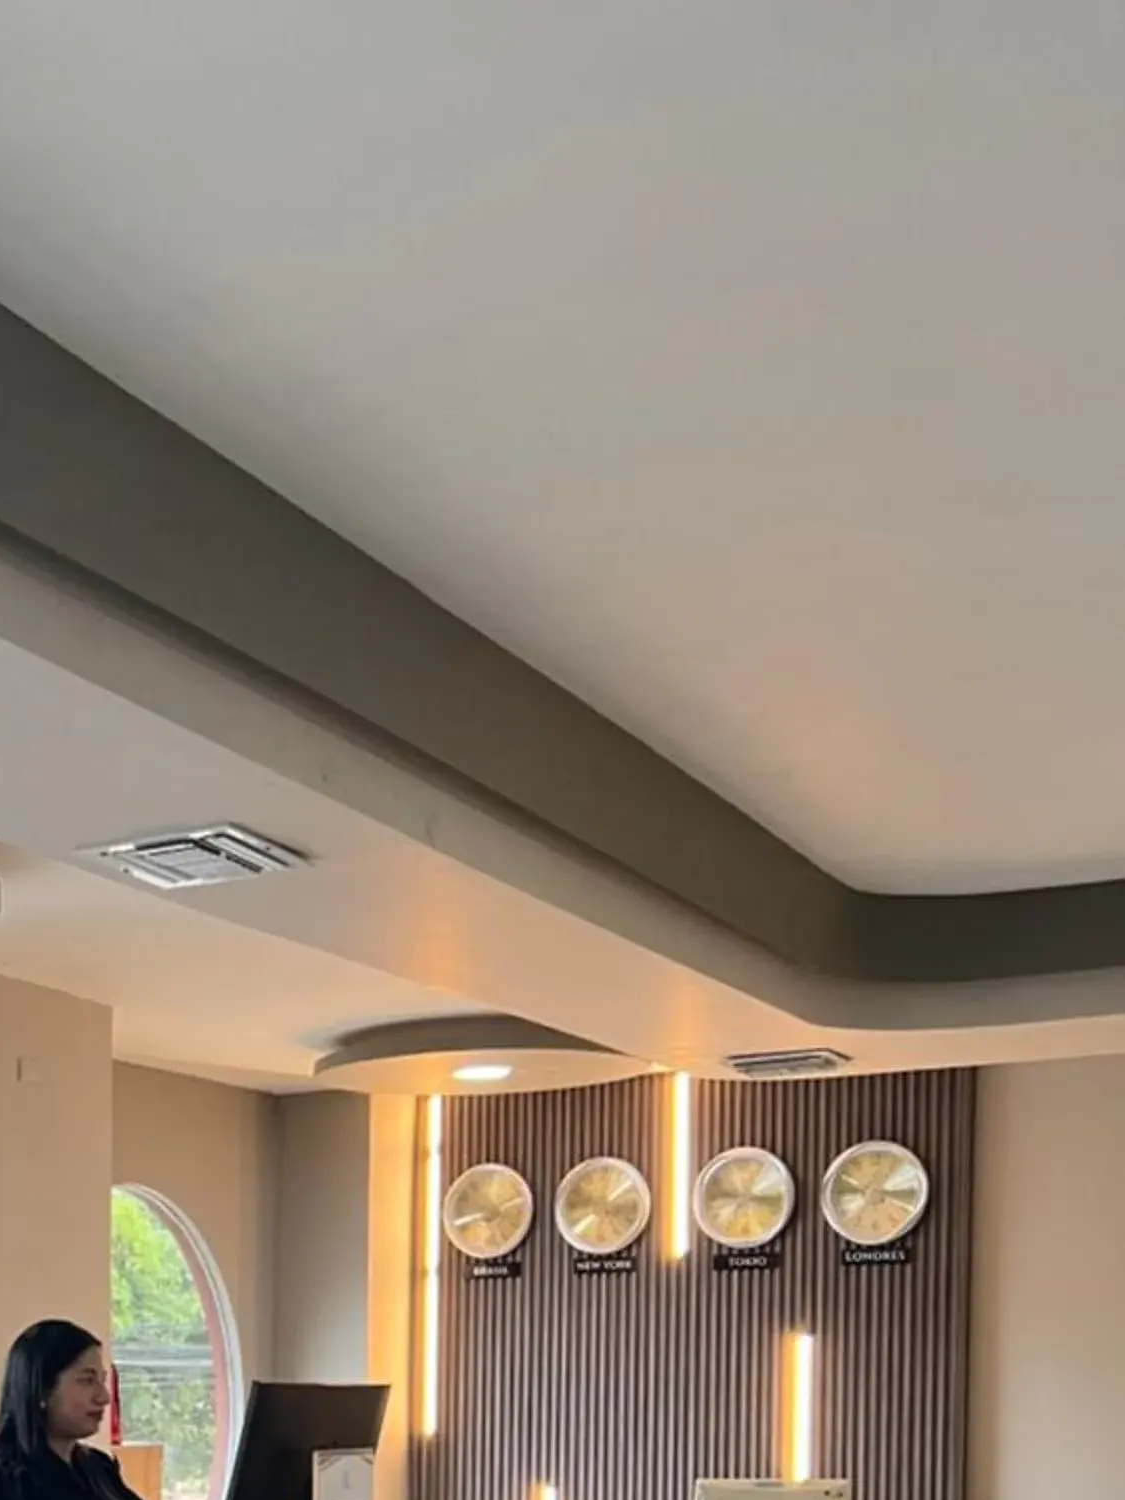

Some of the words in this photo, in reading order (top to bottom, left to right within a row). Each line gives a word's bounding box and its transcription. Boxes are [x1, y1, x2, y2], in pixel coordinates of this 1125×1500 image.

[845, 1250, 906, 1263] LONDRES
[576, 1261, 601, 1272] NEW
[603, 1258, 632, 1270] YORK
